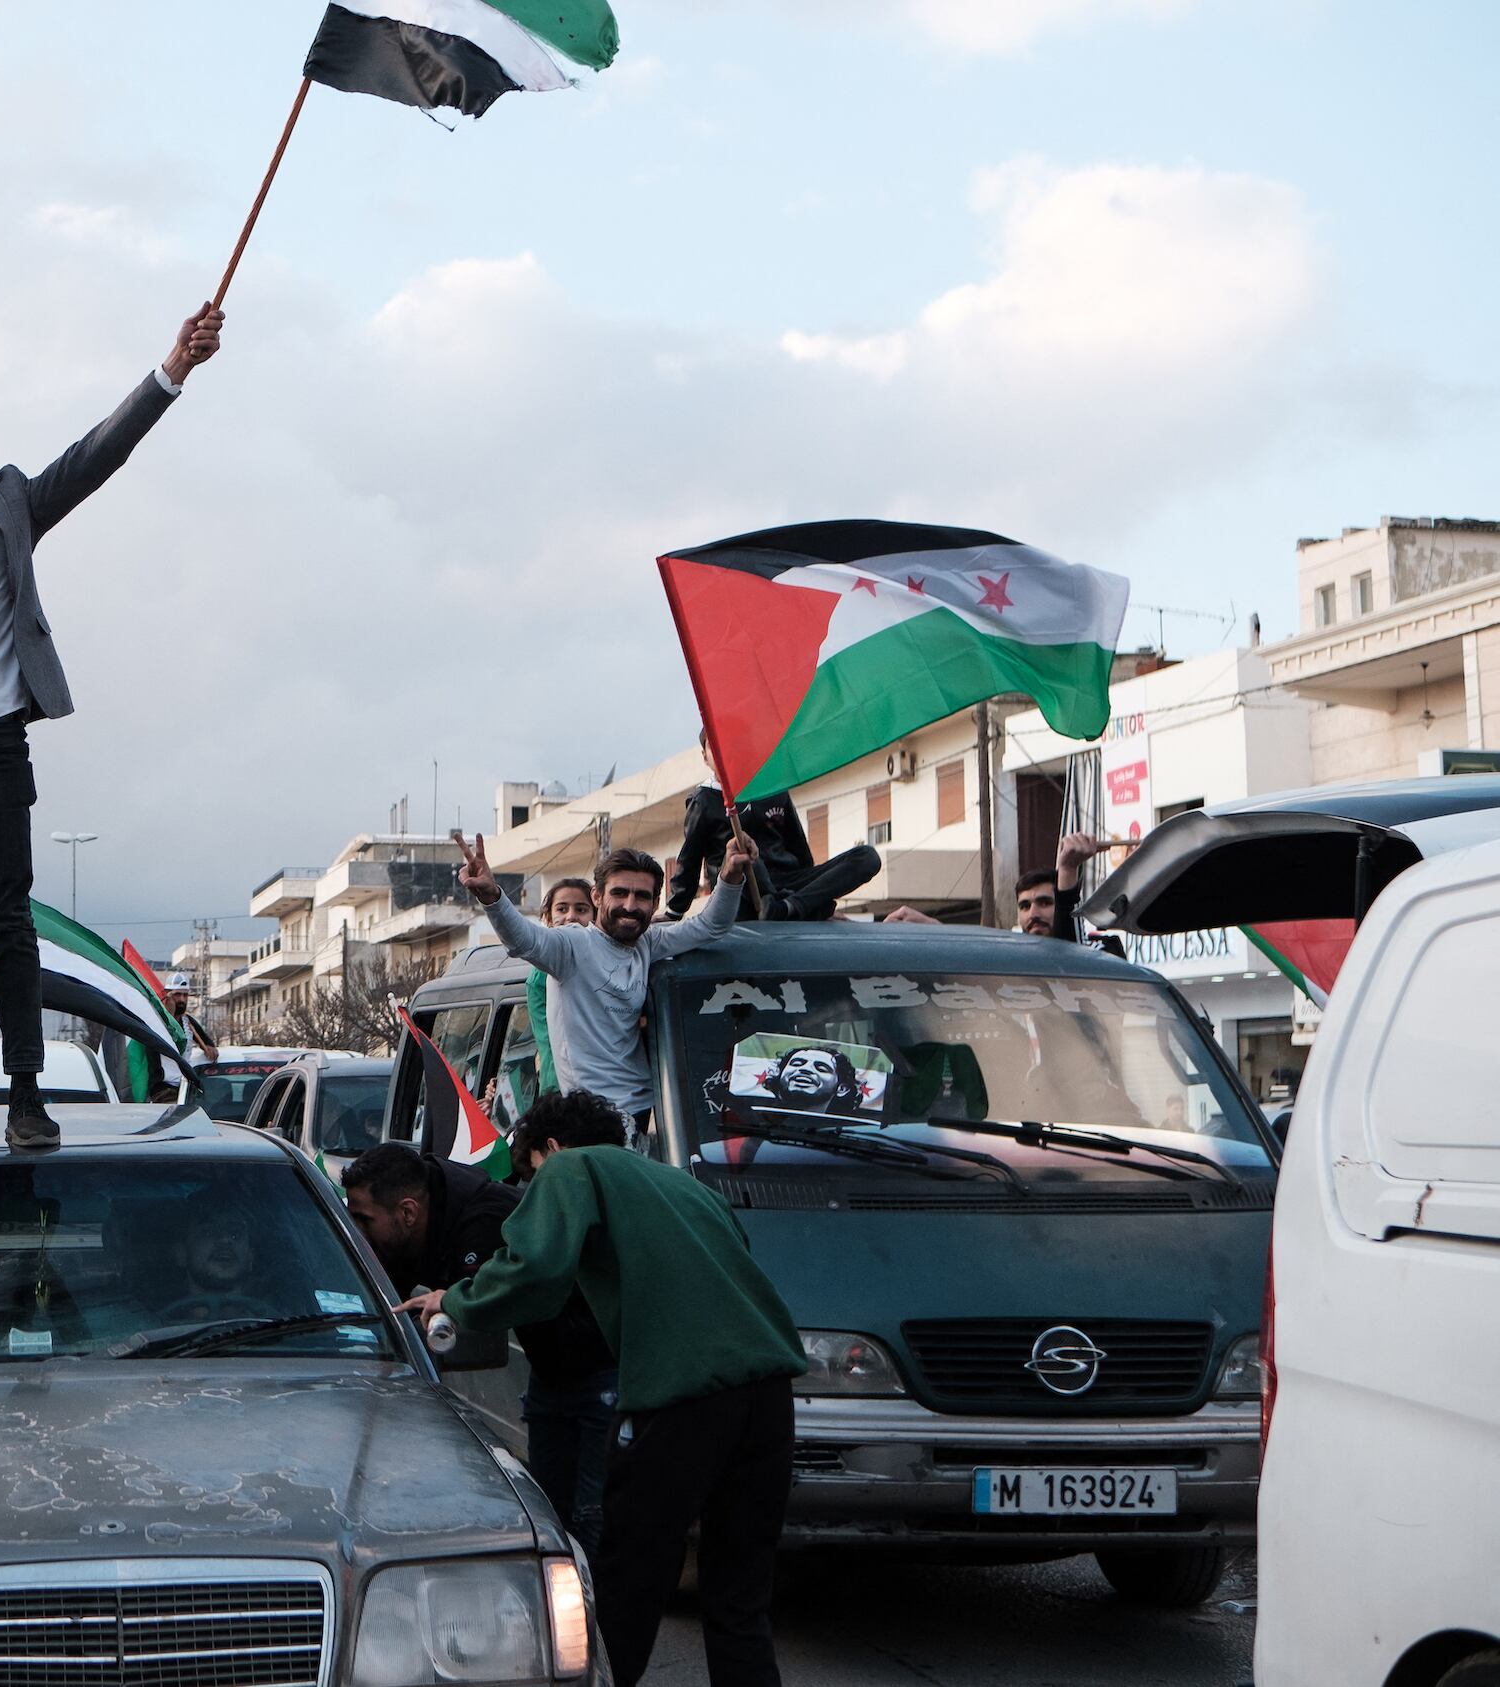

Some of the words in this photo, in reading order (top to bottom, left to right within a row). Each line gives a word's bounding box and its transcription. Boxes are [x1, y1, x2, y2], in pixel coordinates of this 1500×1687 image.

[700, 979, 807, 1015] Al
[999, 1475, 1021, 1508] M
[1045, 1475, 1155, 1508] 163924
